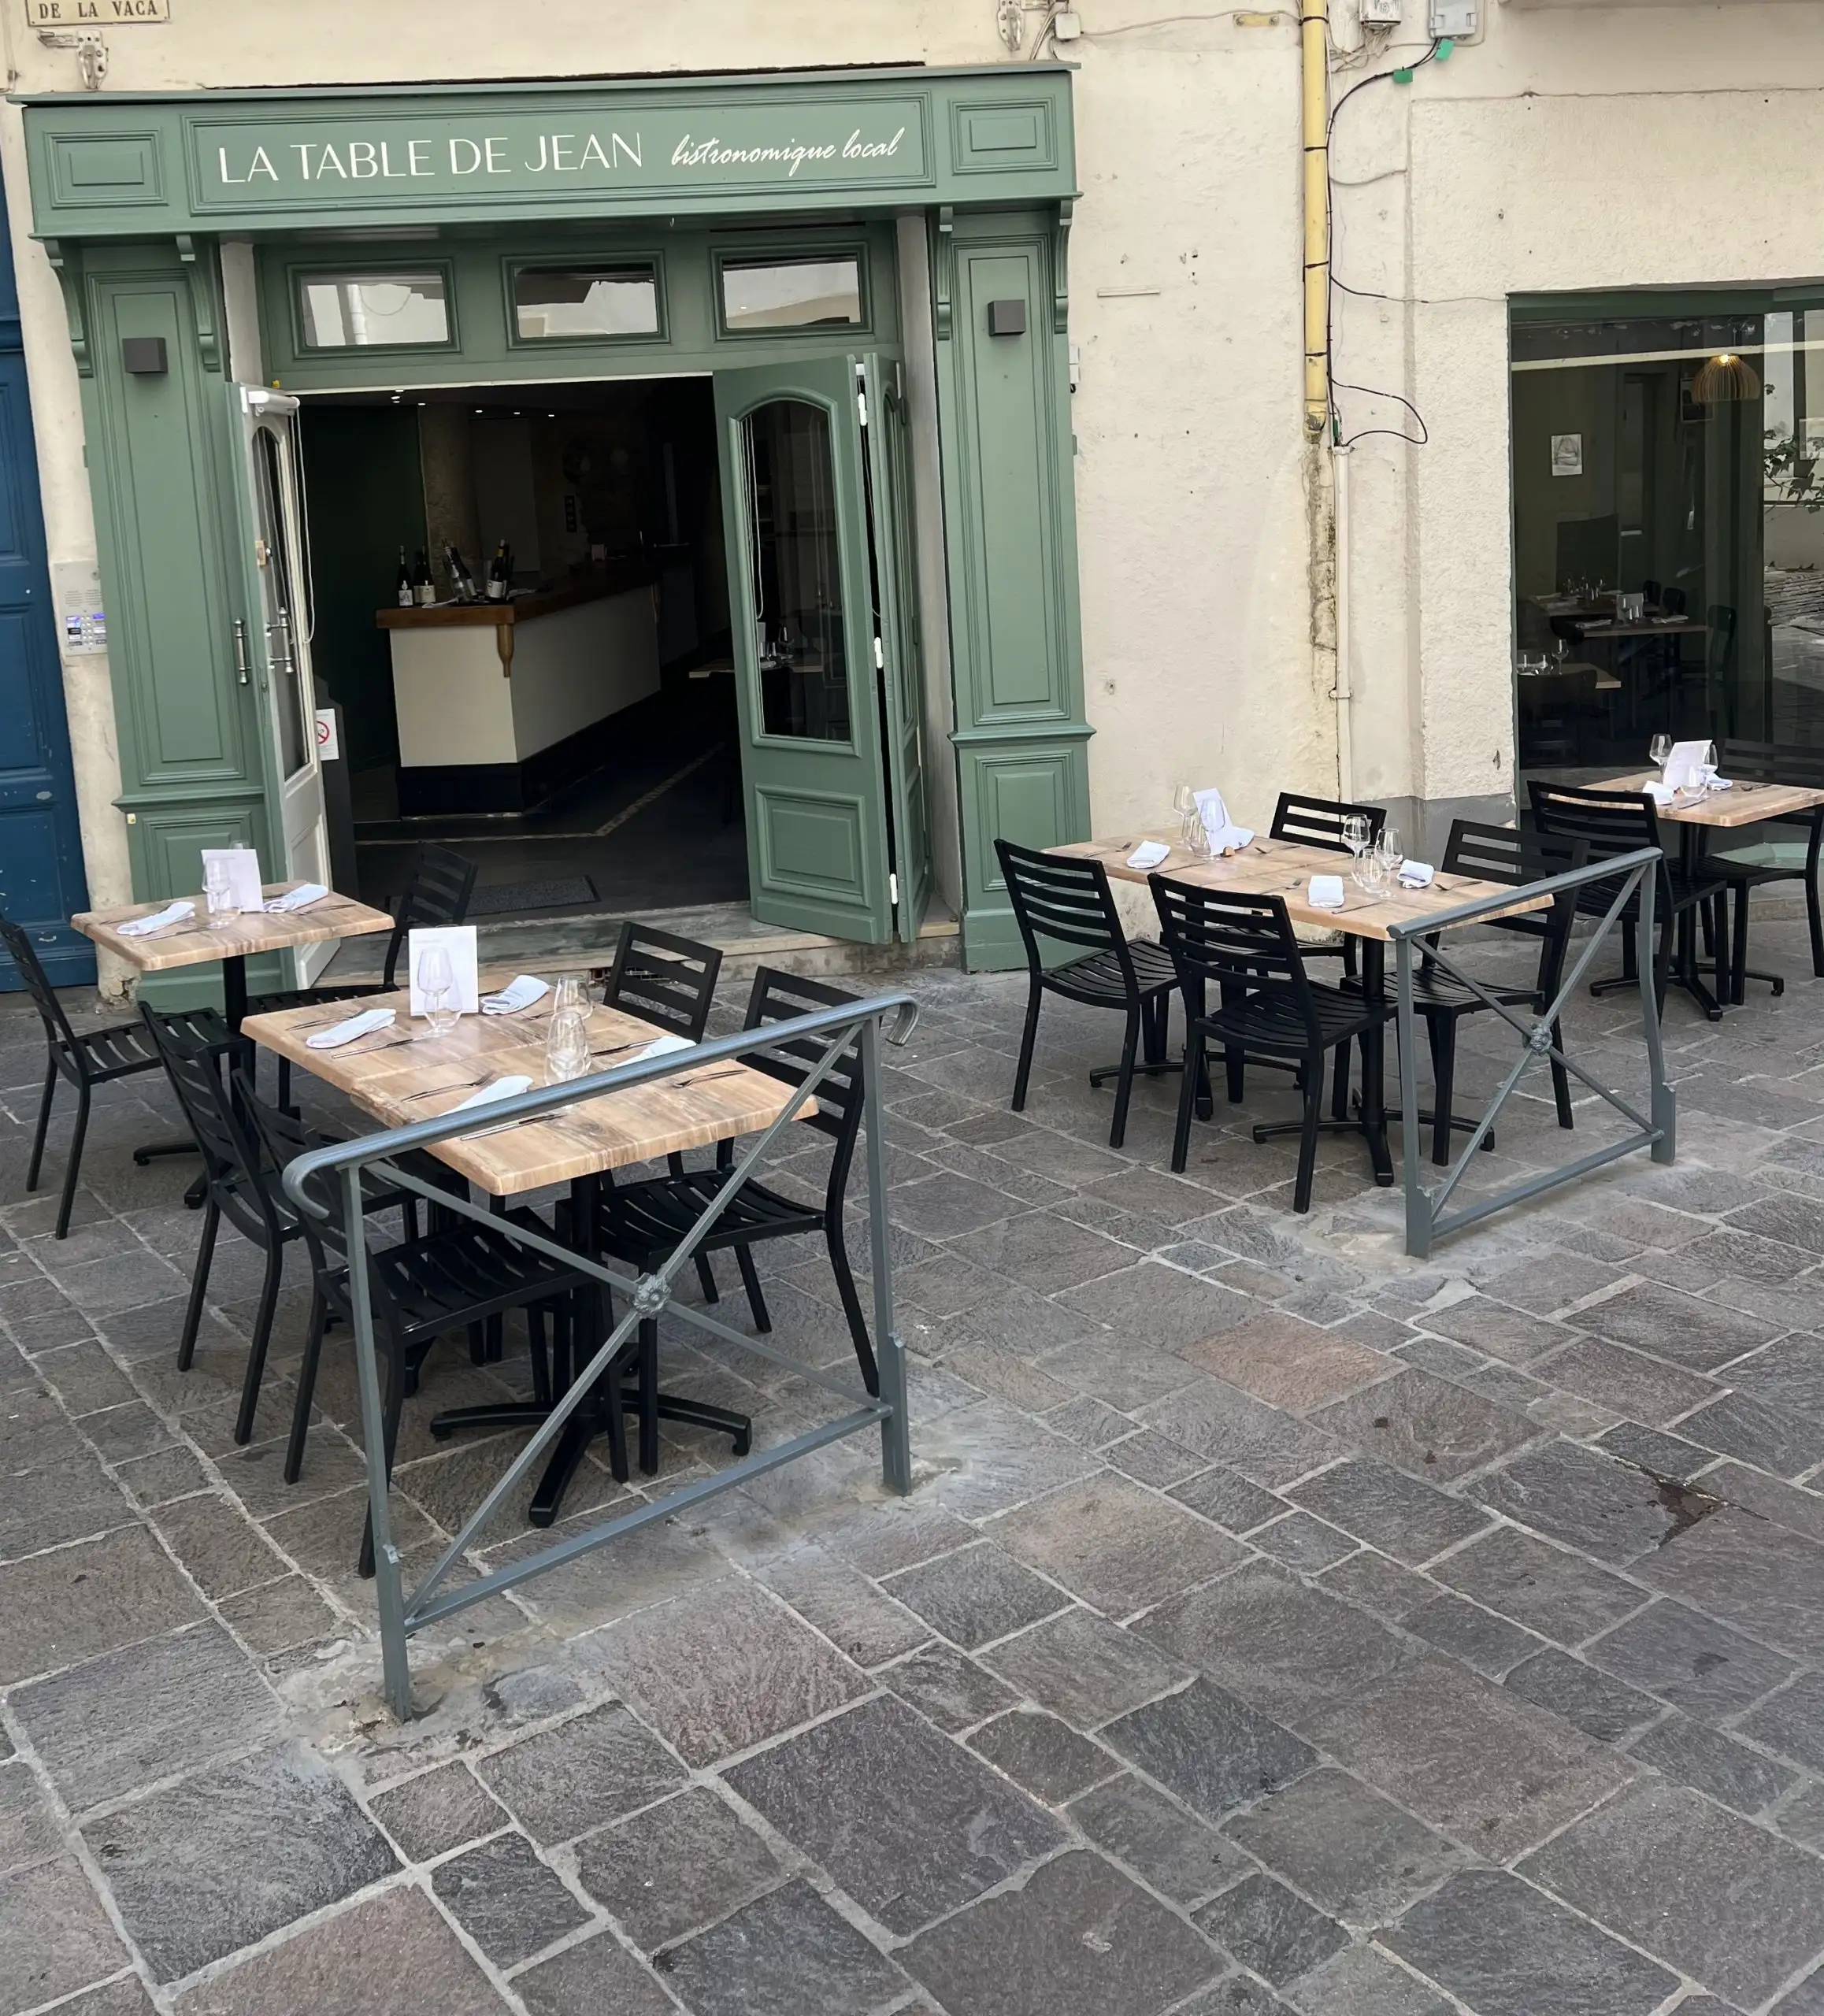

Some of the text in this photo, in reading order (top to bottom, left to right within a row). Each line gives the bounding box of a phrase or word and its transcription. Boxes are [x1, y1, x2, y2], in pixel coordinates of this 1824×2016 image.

[39, 0, 158, 20] DE LA VACA
[219, 126, 906, 183] LA TABLE DE JEAN bistronomique local
